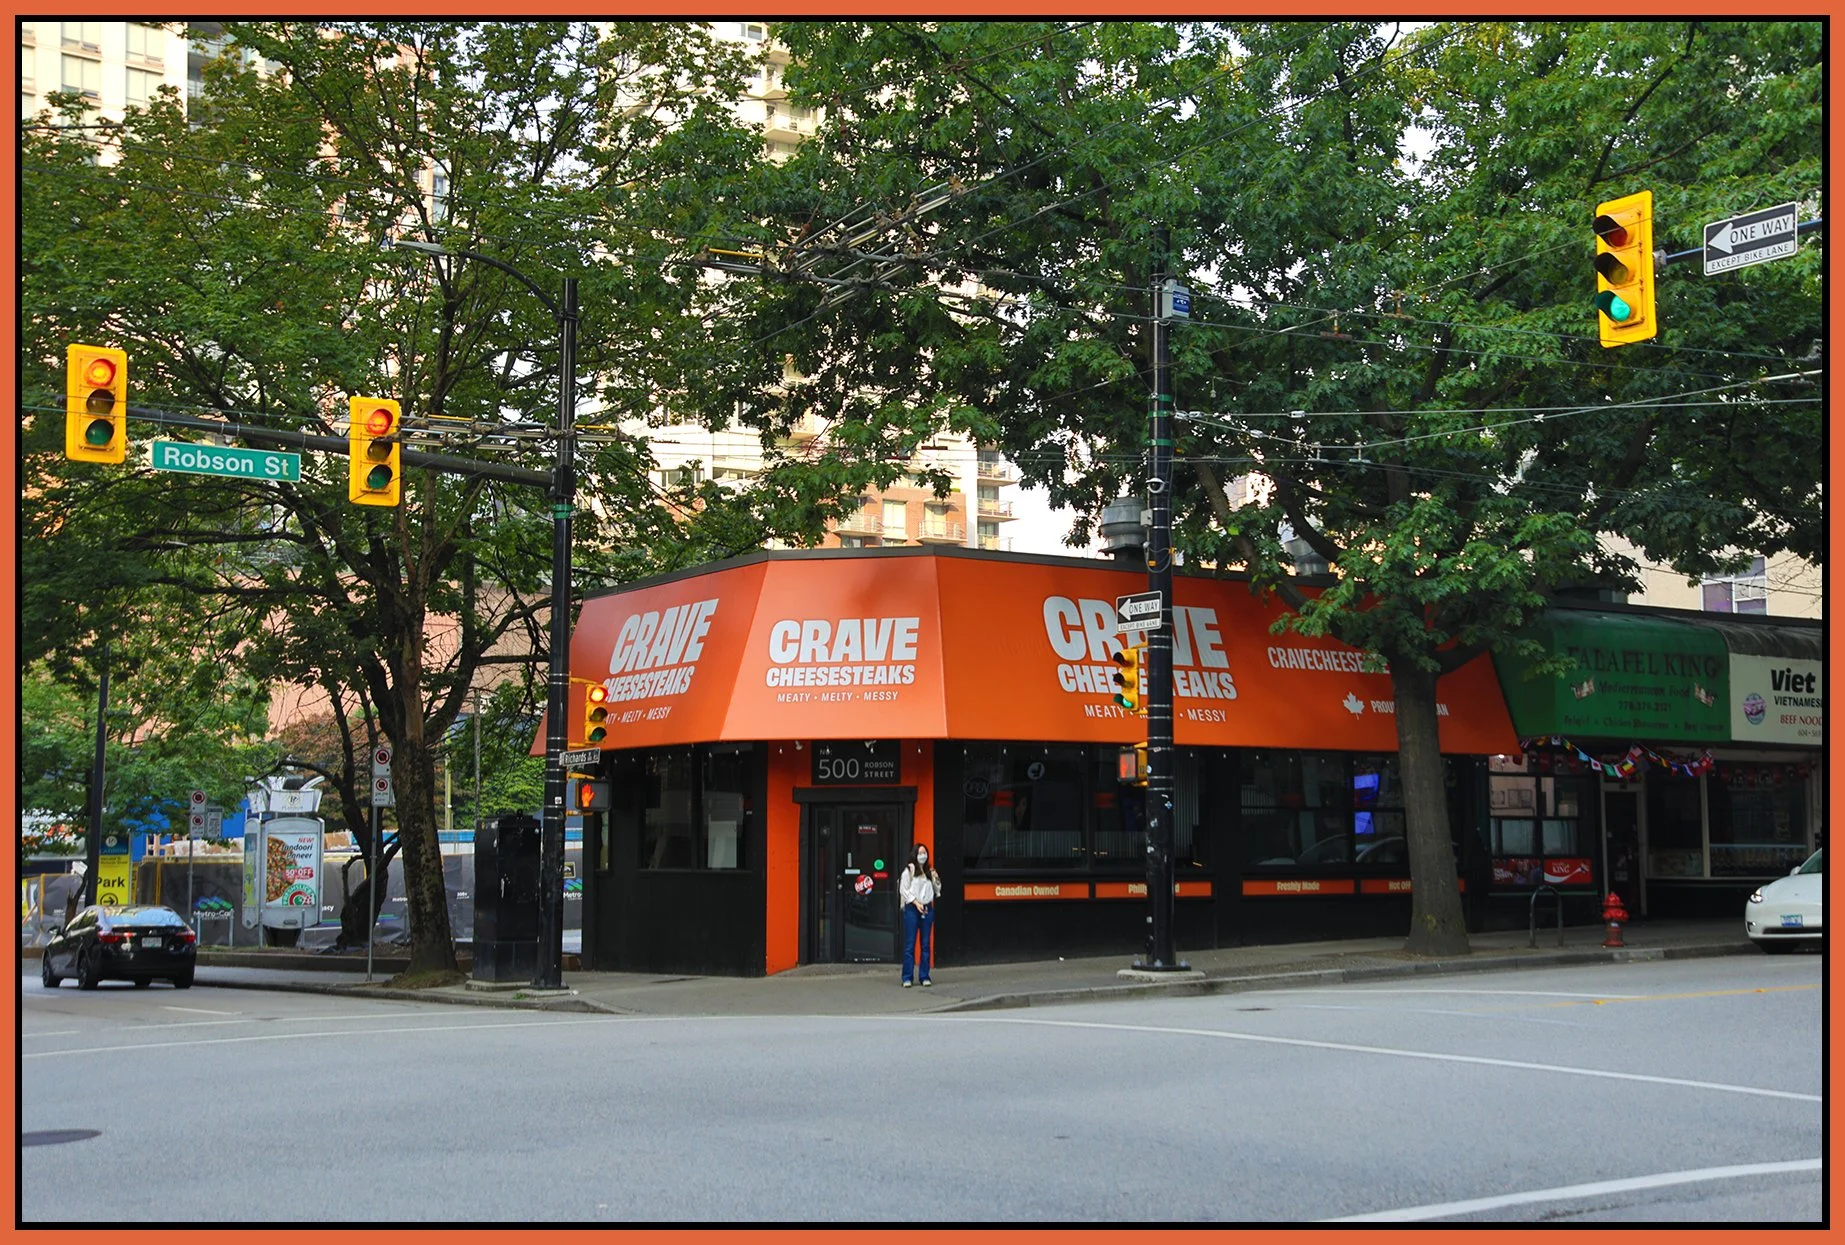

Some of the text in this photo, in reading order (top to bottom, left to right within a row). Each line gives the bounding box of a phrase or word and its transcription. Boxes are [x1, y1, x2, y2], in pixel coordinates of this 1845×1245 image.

[1730, 217, 1790, 244] ONE WAY
[1711, 243, 1789, 270] EXCEPT BIKE LANE
[164, 446, 289, 476] Robson St
[1128, 600, 1158, 614] ONE WAY
[609, 598, 719, 675] CRAVE
[769, 617, 920, 664] CRAVE
[1567, 647, 1719, 679] FALAFEL KING
[766, 665, 916, 687] CHEESESTEAKS
[1771, 667, 1816, 694] Viet
[777, 691, 898, 702] MEATY MELTY MESSY
[1774, 696, 1822, 708] VIETNAMES
[621, 710, 642, 723] MELTY
[646, 705, 671, 720] MESSY
[1084, 704, 1126, 718] MEATY
[1187, 709, 1227, 722] MESSY
[1780, 714, 1797, 725] BEEF
[565, 752, 587, 763] Richards
[818, 759, 860, 779] 500
[298, 868, 312, 876] OFF
[996, 885, 1059, 896] Canadian Owned
[1277, 881, 1320, 892] Freshly Made
